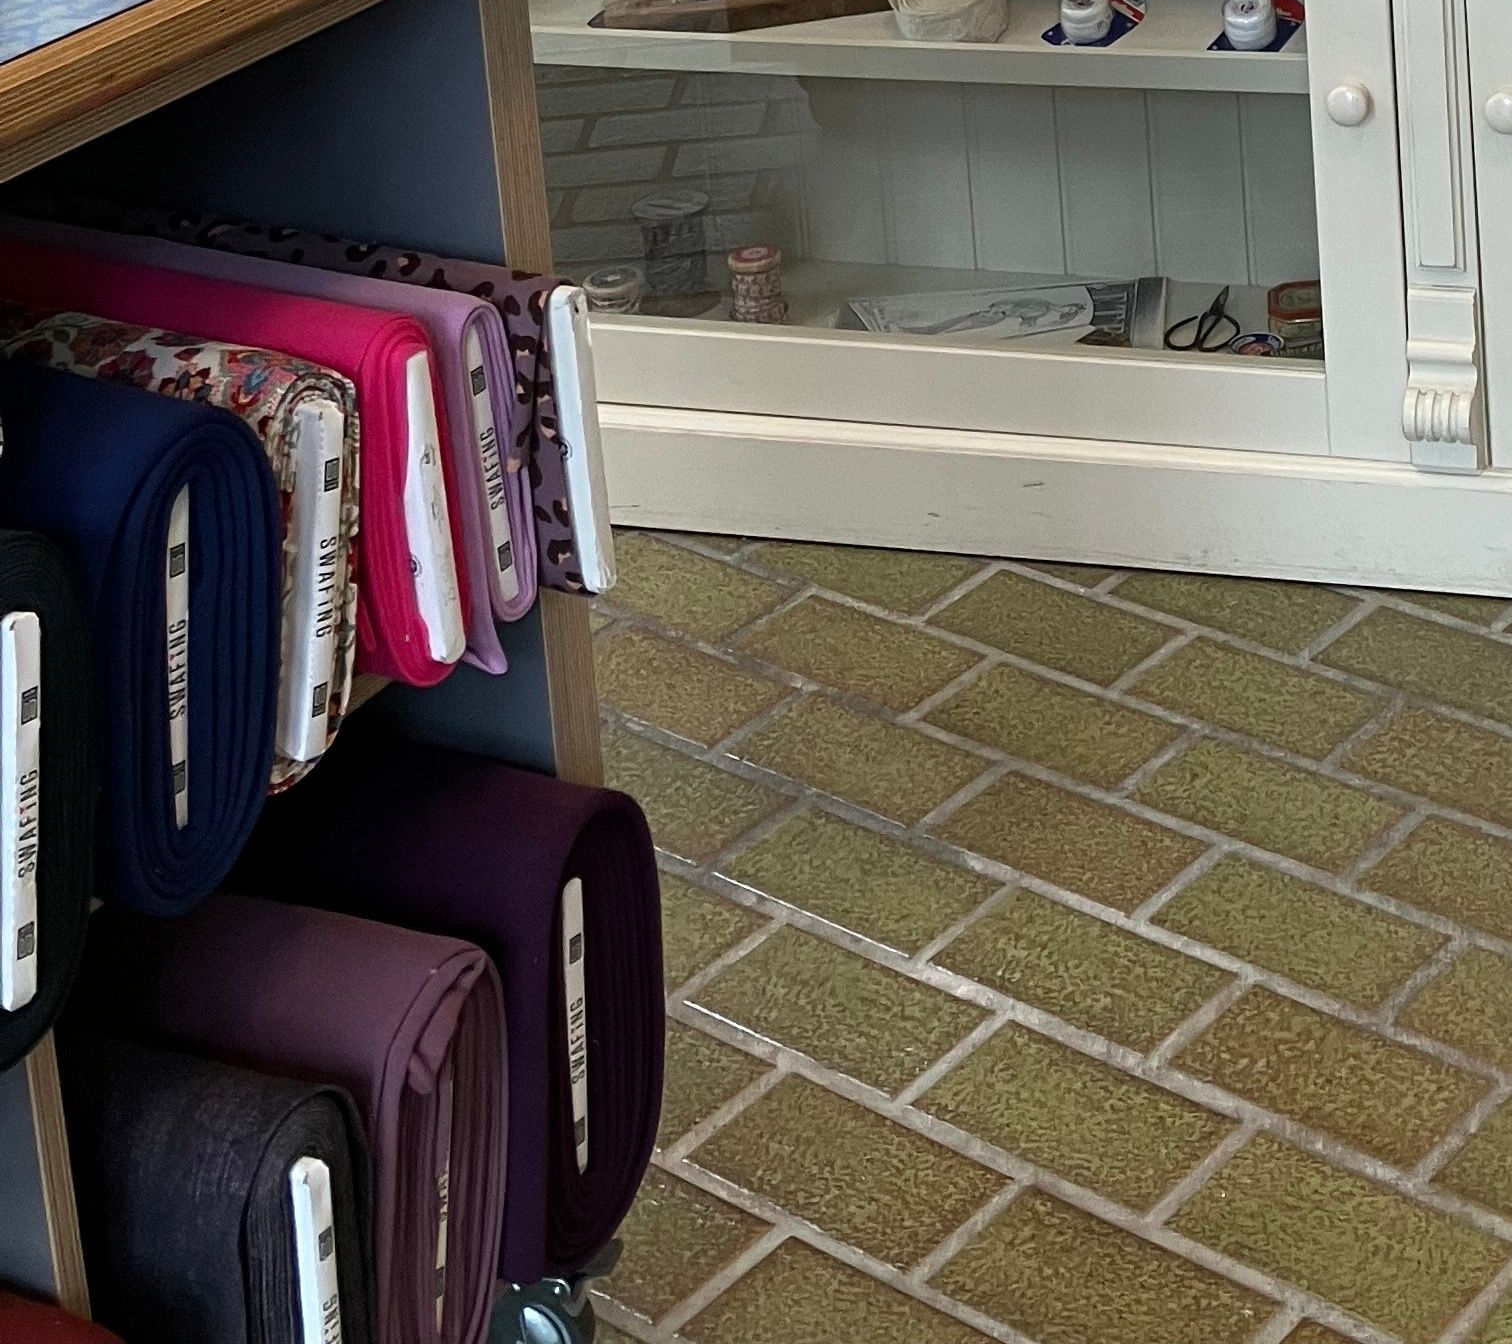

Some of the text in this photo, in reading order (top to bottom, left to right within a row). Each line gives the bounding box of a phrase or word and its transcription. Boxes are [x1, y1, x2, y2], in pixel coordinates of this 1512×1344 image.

[477, 425, 507, 512] SWAFING
[315, 536, 339, 641] SWAFING
[168, 616, 189, 722] SWAFING
[17, 767, 39, 880] SWAFING
[568, 995, 586, 1086] SWAFING
